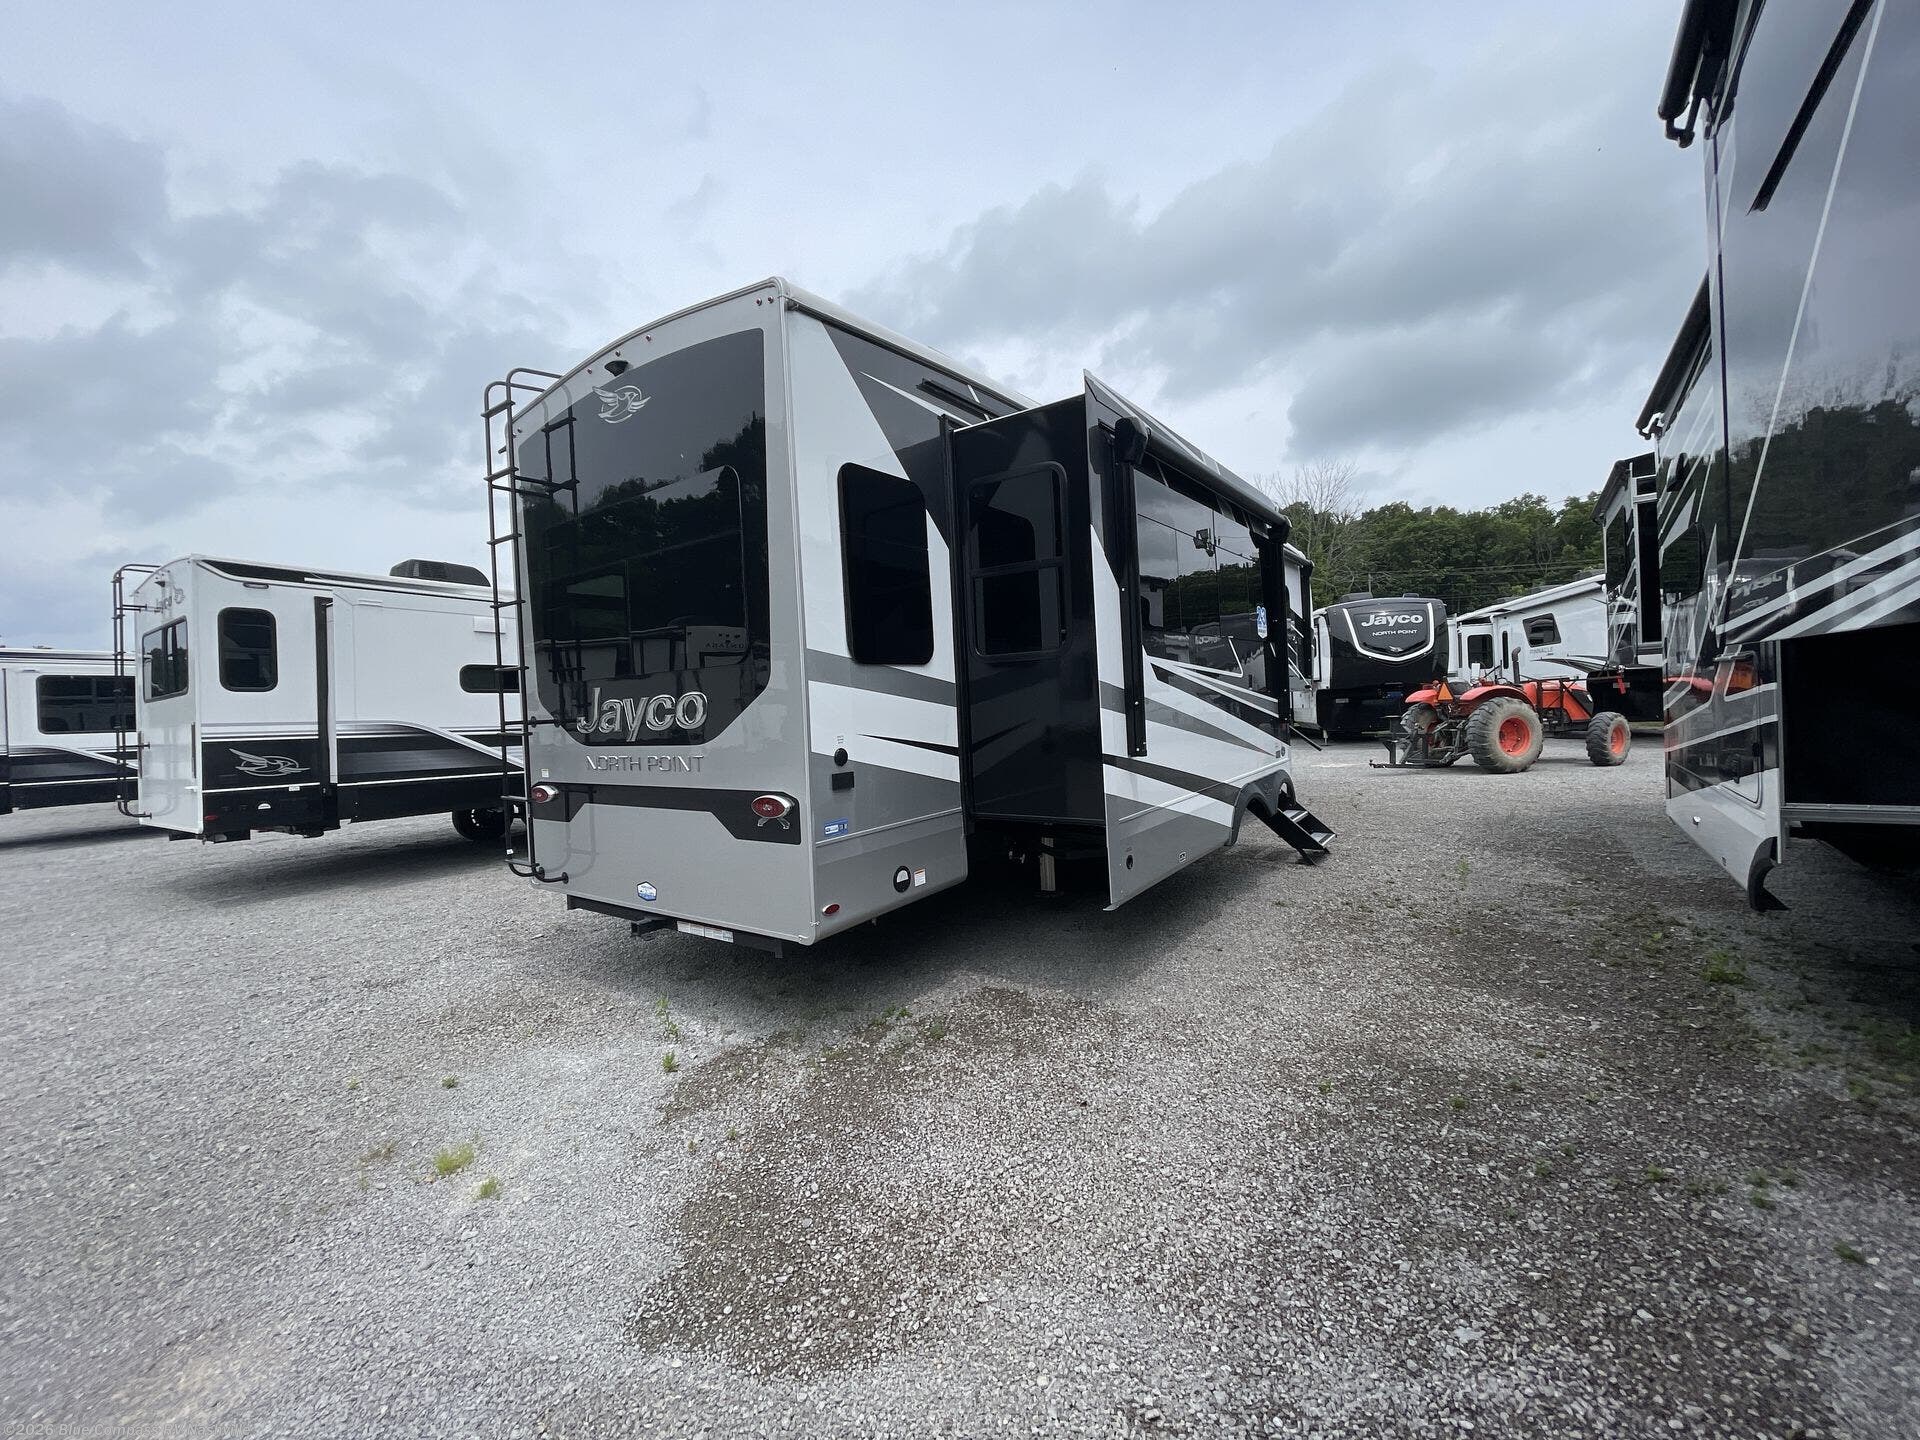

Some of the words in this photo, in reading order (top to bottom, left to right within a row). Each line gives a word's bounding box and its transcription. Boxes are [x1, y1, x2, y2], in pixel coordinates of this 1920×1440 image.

[1361, 614, 1424, 627] Jayco
[576, 687, 708, 742] Jayco
[586, 755, 641, 771] NORTH
[647, 755, 704, 772] POINT
